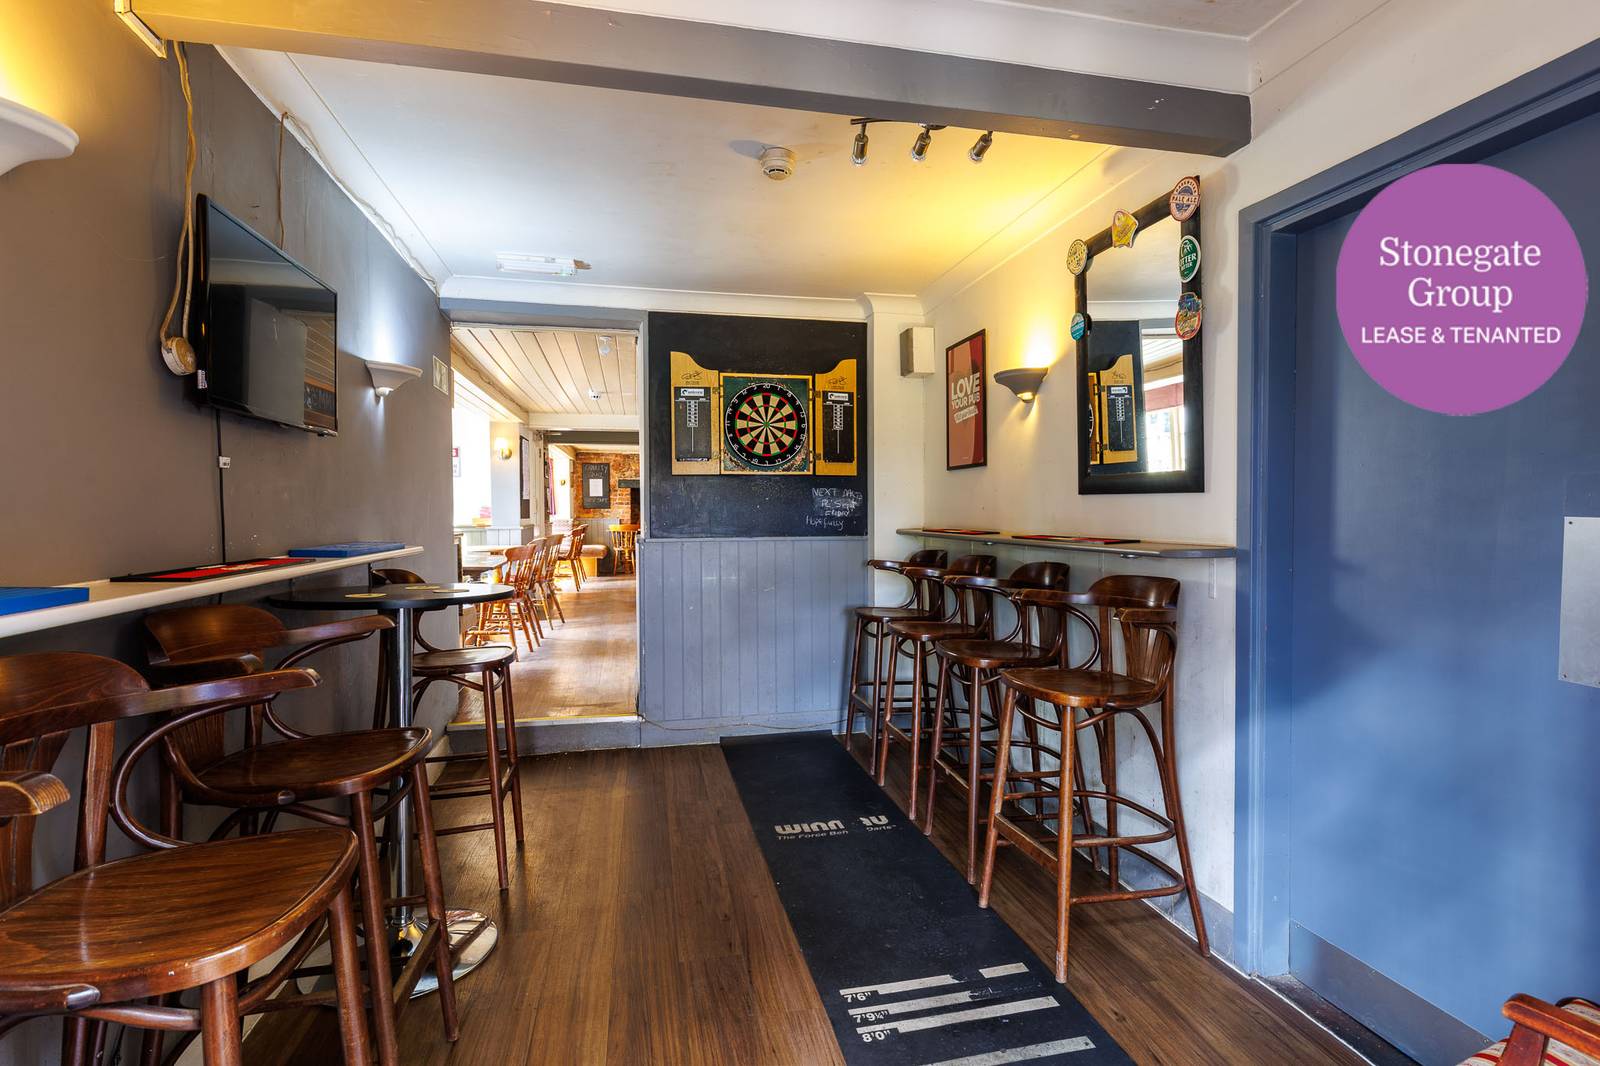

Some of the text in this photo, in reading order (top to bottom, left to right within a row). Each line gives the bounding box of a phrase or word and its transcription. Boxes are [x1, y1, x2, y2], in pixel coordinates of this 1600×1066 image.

[1172, 195, 1198, 203] PALE ALE
[951, 372, 980, 401] LOVE
[951, 397, 968, 410] YOUR
[811, 487, 837, 498] NEXT
[843, 991, 872, 1003] 7'6"
[862, 1029, 891, 1043] 8'0"
